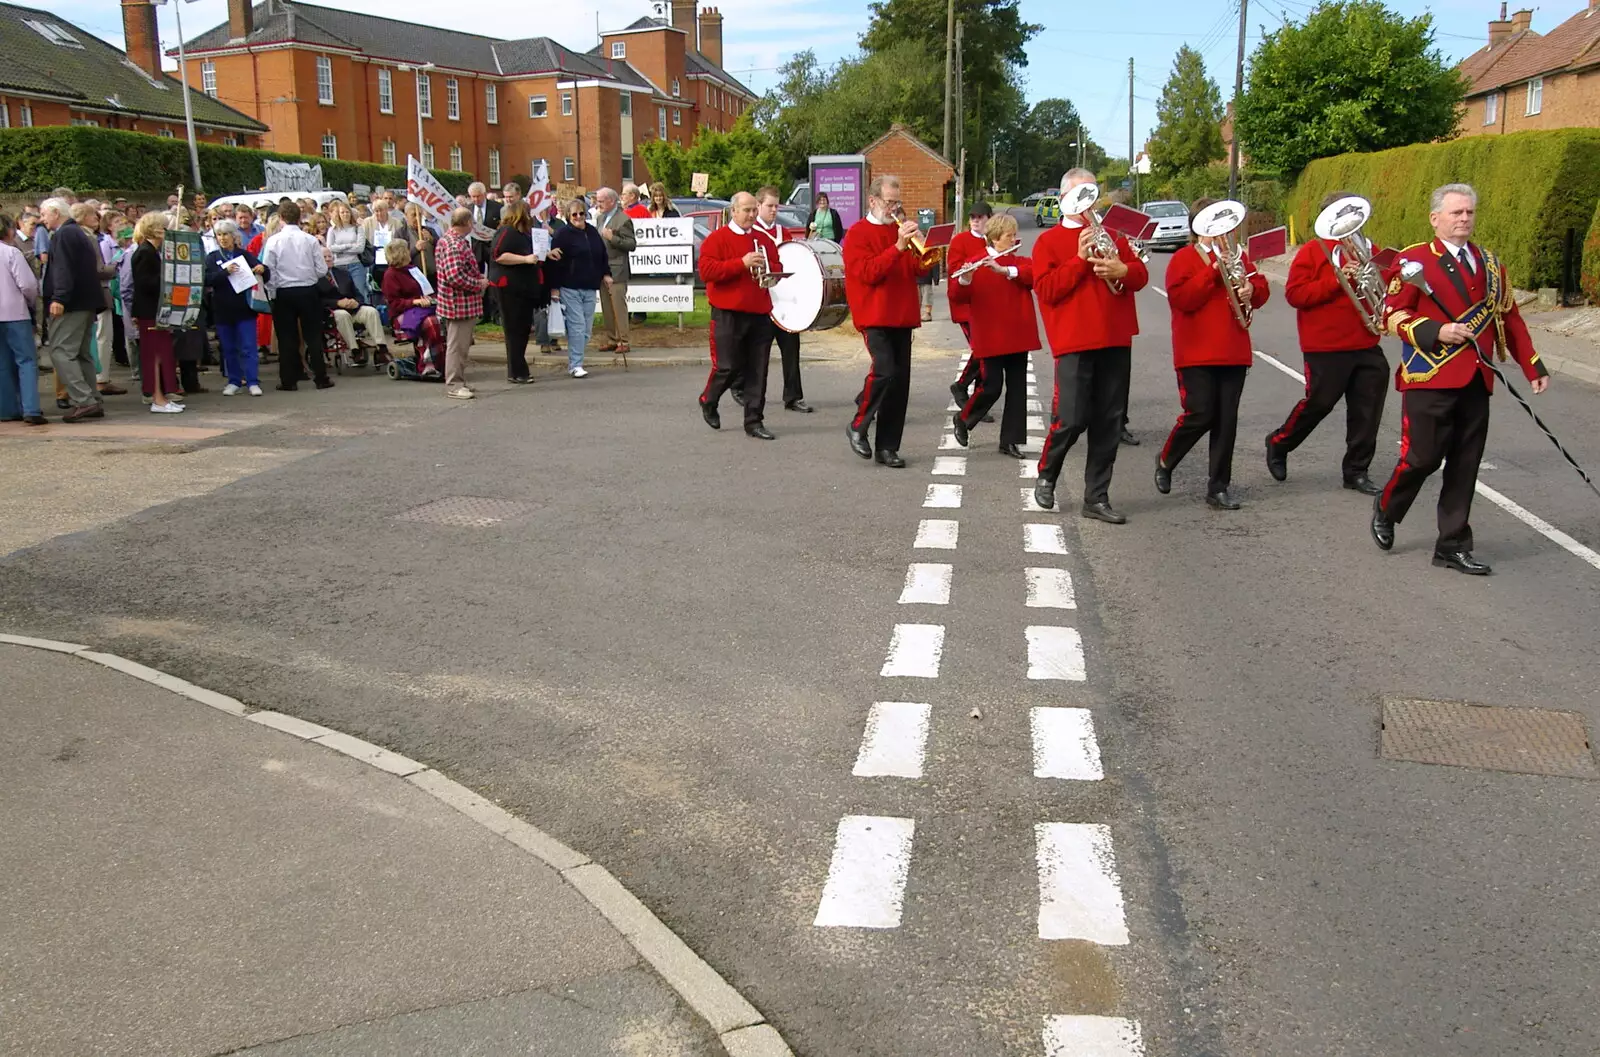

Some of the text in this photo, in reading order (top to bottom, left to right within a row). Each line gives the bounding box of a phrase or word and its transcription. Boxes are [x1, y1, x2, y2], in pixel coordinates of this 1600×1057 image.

[408, 179, 452, 216] SAVE
[635, 224, 682, 239] entre.
[630, 254, 689, 265] THING UNIT
[626, 294, 689, 303] Medicine Centre
